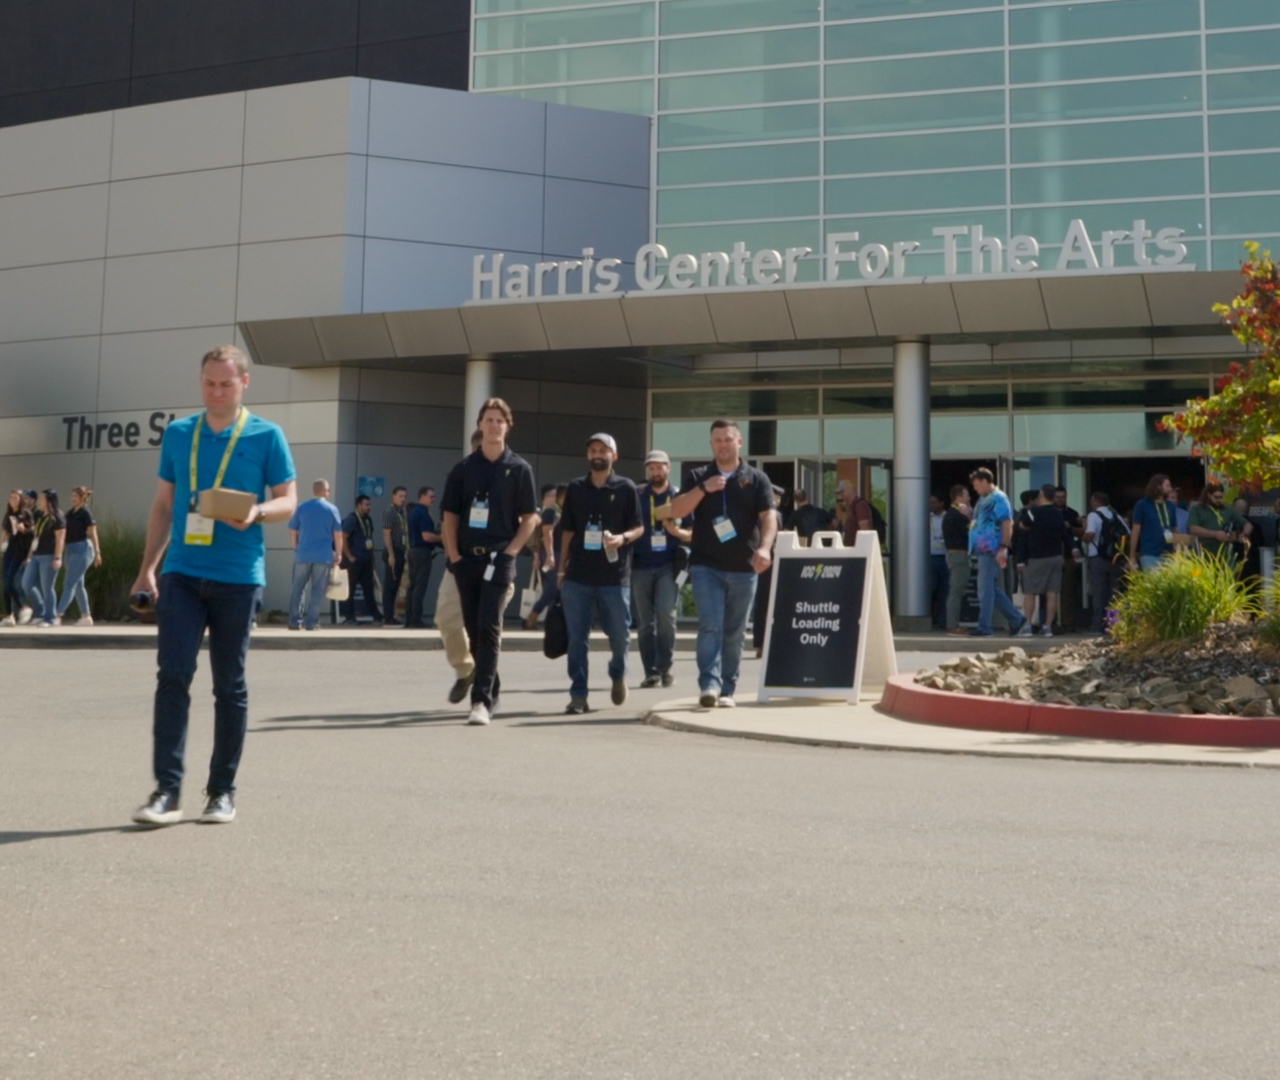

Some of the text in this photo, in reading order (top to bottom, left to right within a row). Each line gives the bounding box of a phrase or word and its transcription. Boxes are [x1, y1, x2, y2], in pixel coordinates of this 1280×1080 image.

[471, 219, 1188, 300] Harris Center For The Arts
[63, 416, 140, 450] Three
[795, 602, 840, 613] Shuttle
[792, 617, 840, 631] Loading
[800, 633, 828, 647] Only
